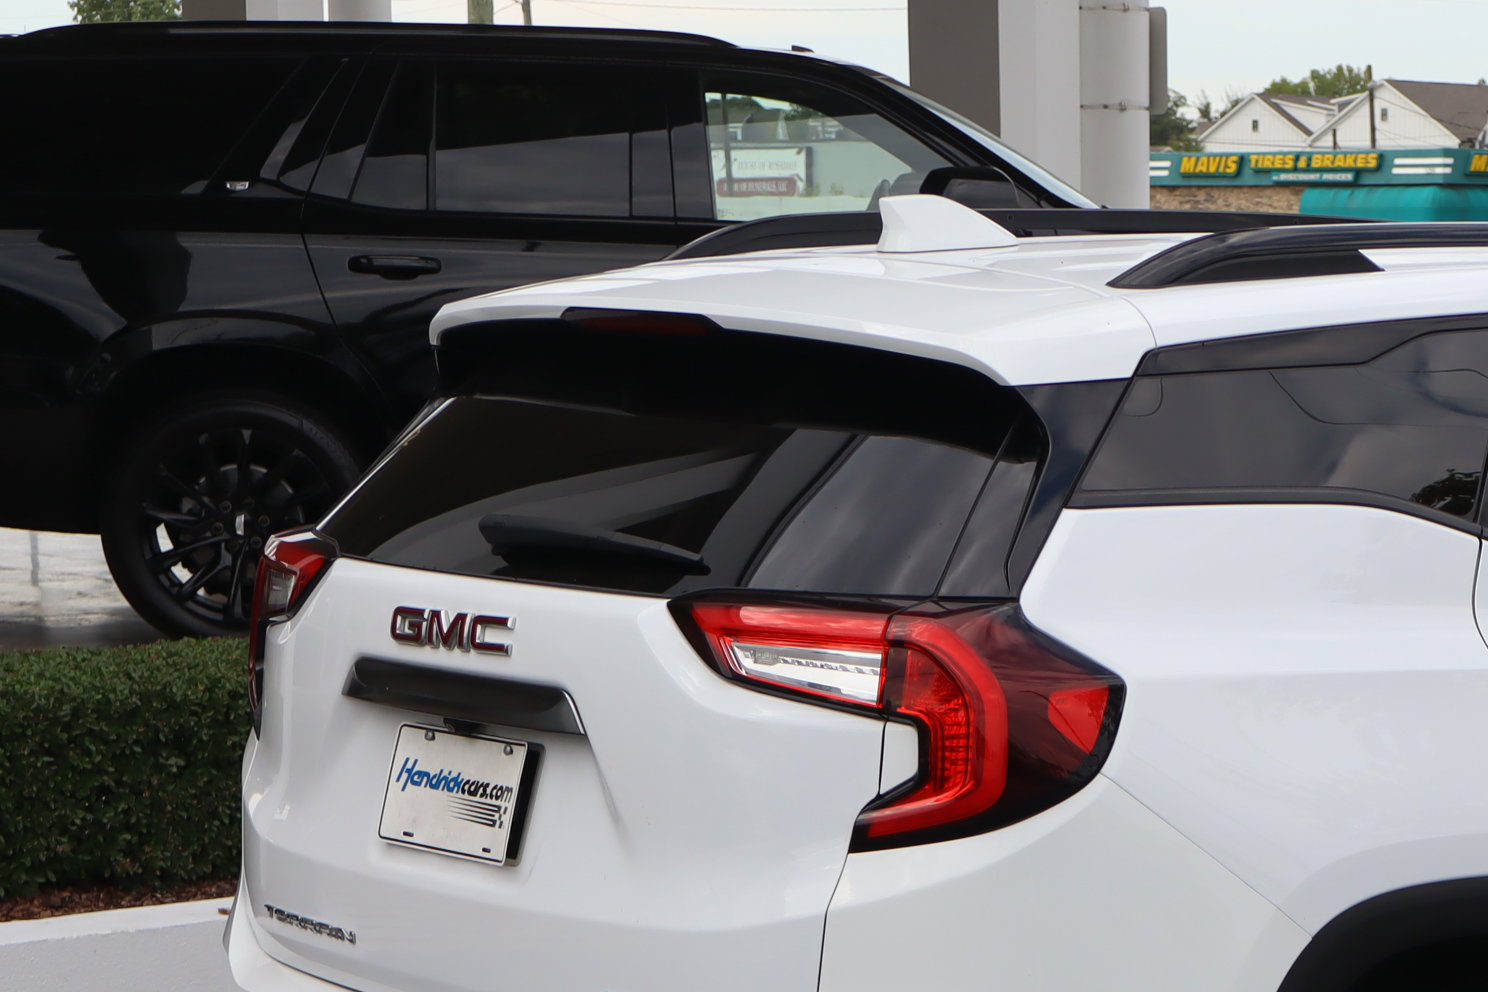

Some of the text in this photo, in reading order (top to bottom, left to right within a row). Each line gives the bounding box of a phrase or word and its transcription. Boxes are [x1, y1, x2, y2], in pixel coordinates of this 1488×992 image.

[1180, 153, 1378, 174] MAVIS TIRES & BRAKES
[1279, 173, 1320, 181] DISCOUNT
[1322, 173, 1354, 181] PRICES
[390, 606, 517, 657] GMC
[396, 757, 514, 803] Hendrickcars.com
